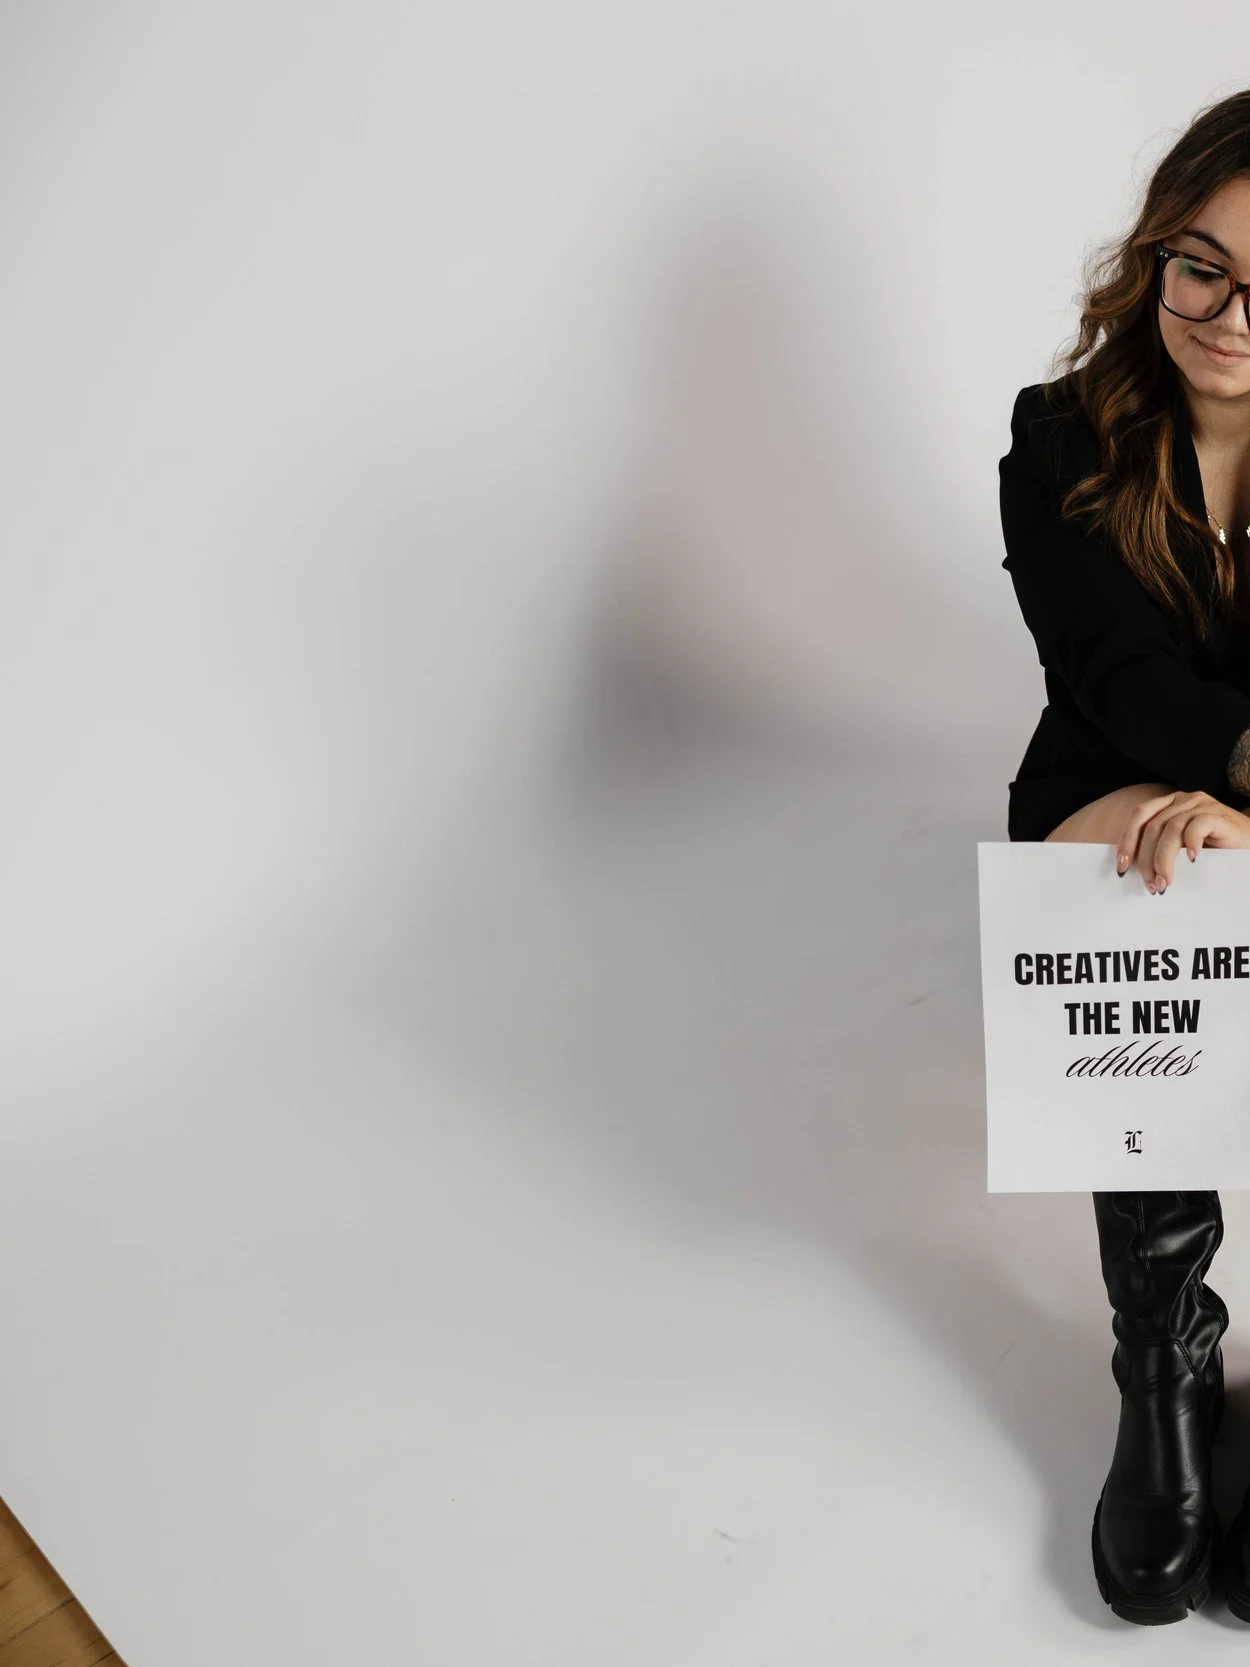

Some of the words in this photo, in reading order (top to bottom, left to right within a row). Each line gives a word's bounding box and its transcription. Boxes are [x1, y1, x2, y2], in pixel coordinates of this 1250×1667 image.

[1014, 948, 1180, 986] CREATIVES
[1191, 945, 1250, 980] ARE
[1063, 1001, 1121, 1036] THE
[1132, 999, 1201, 1035] NEW
[1065, 1040, 1203, 1078] athletes
[1124, 1130, 1143, 1155] L
